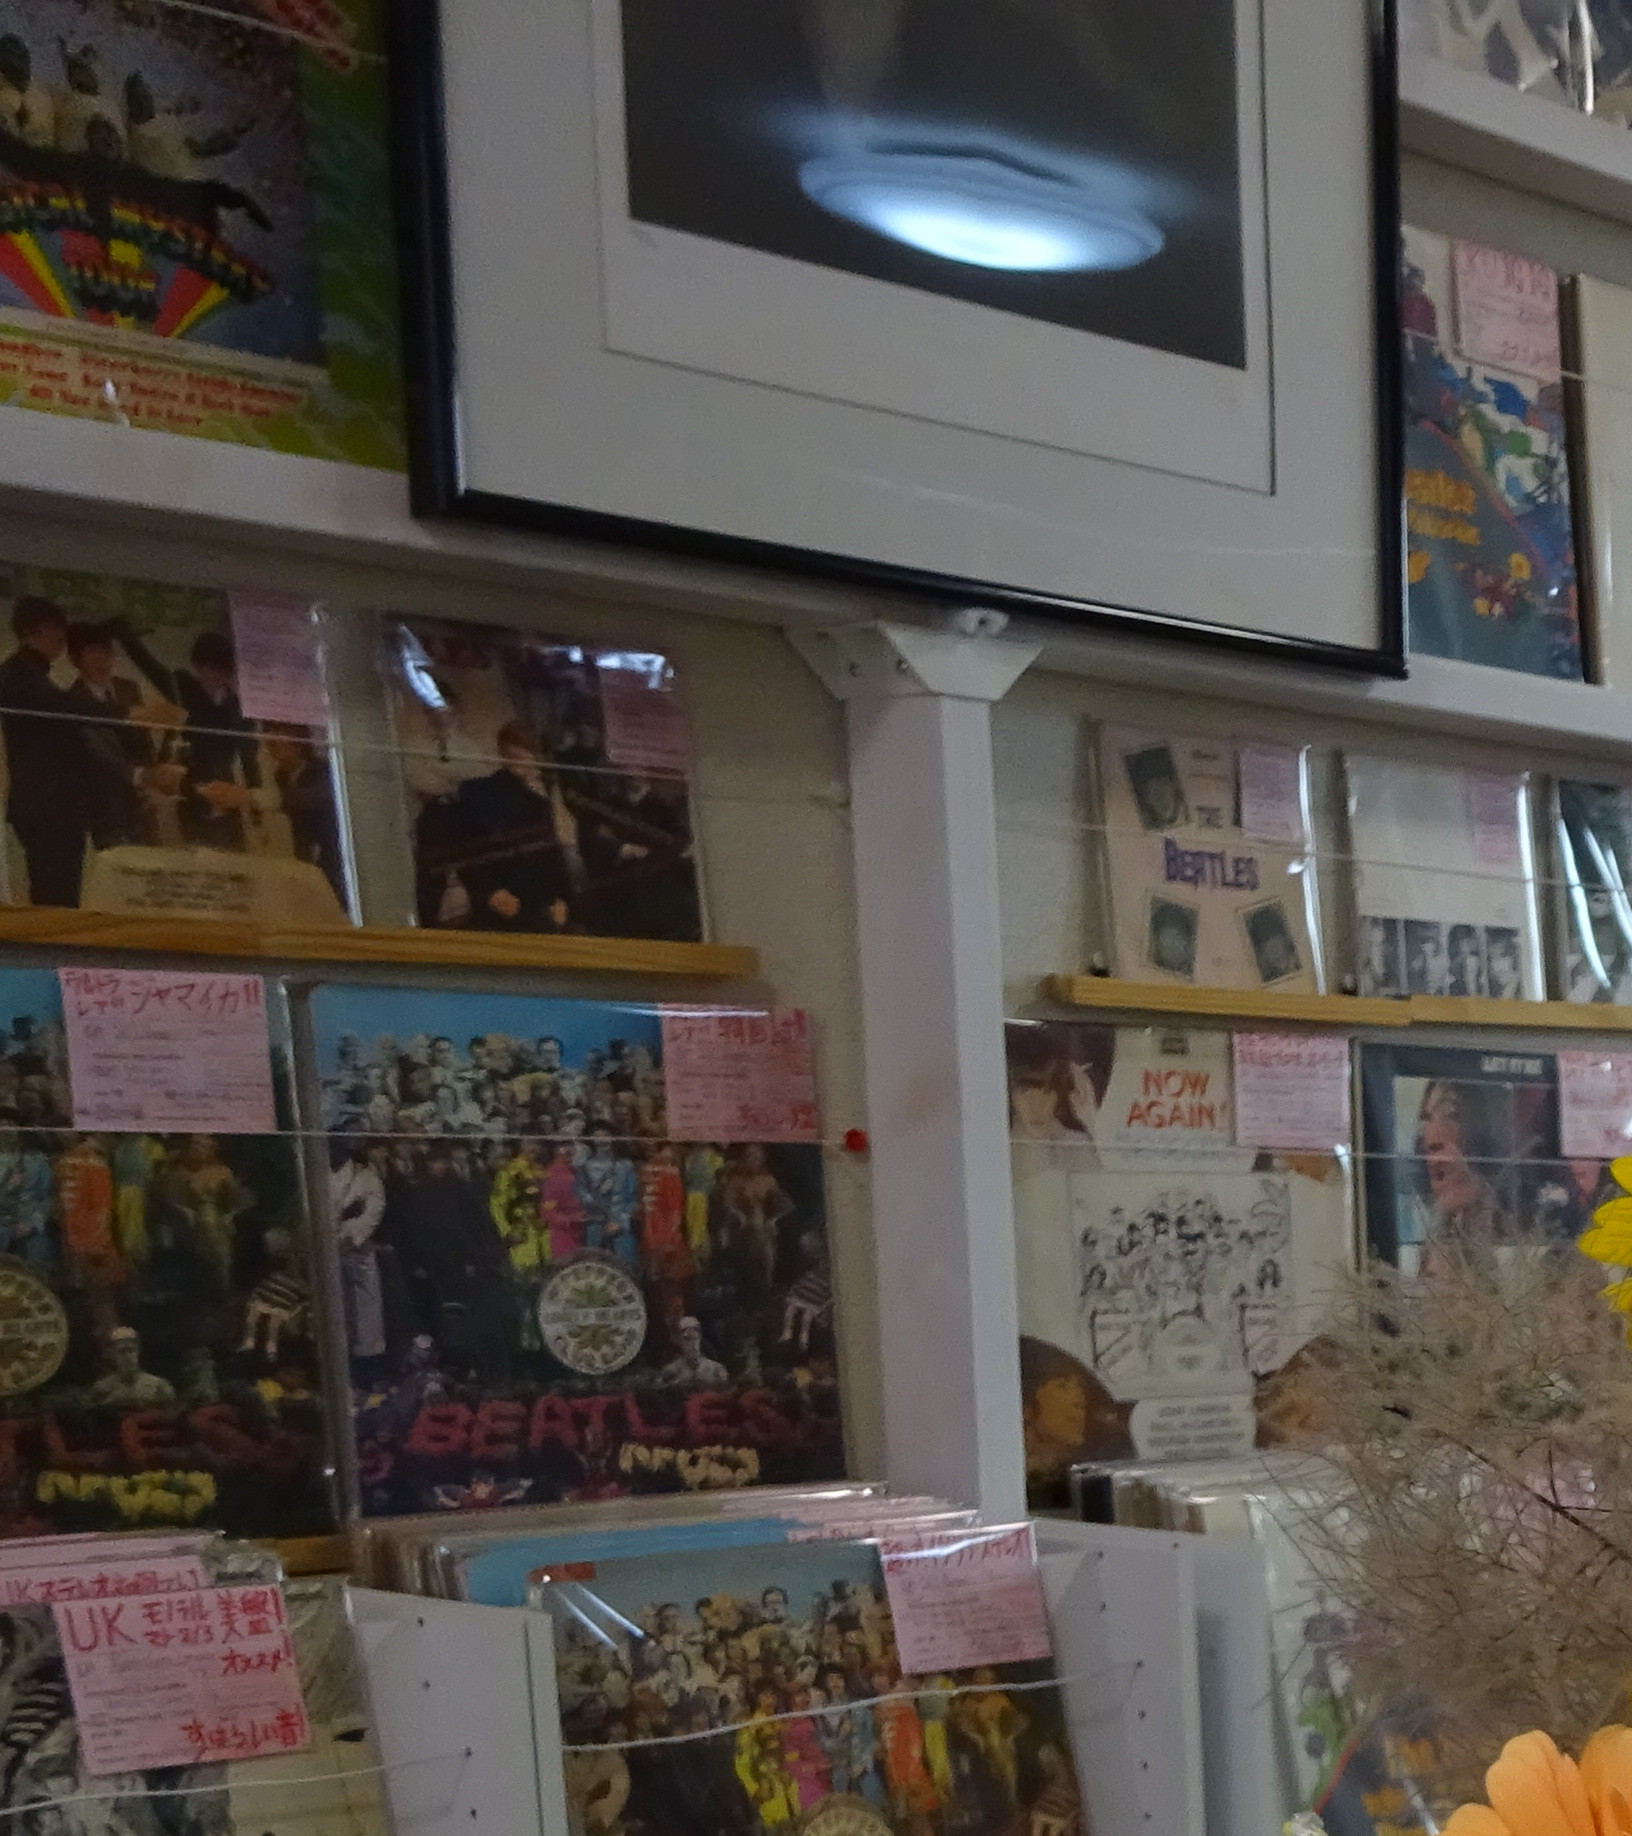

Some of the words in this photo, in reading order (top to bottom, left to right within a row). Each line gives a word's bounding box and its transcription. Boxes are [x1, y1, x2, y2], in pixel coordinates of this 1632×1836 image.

[1141, 1068, 1212, 1099] NOW
[406, 1390, 790, 1458] BEATLES
[64, 1601, 138, 1653] UK
